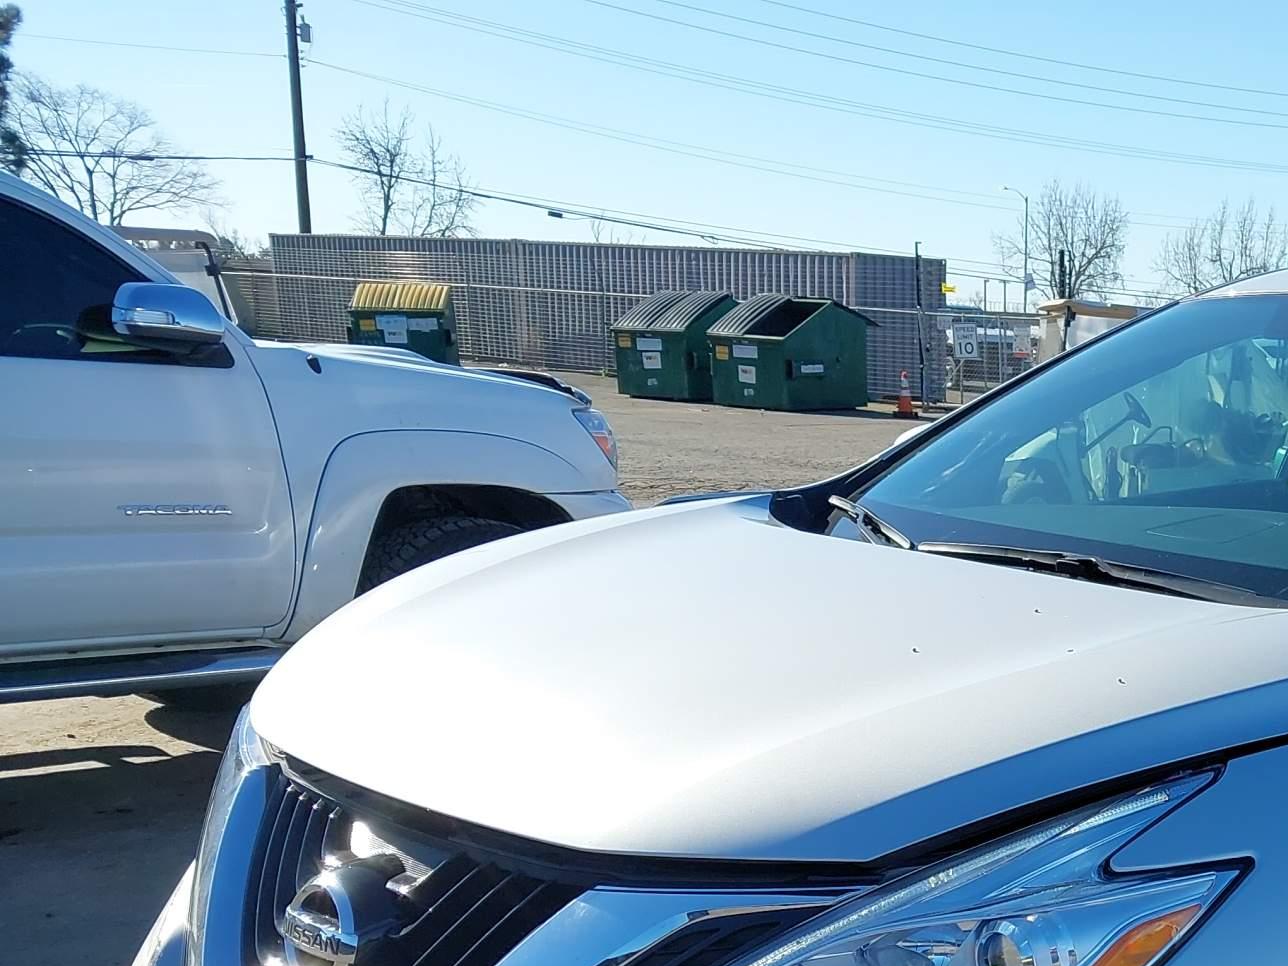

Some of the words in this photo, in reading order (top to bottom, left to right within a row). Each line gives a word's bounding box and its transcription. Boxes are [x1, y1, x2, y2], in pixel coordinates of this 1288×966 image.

[958, 341, 974, 355] 10
[119, 504, 233, 516] TACOMA
[283, 916, 341, 956] NISSAN
